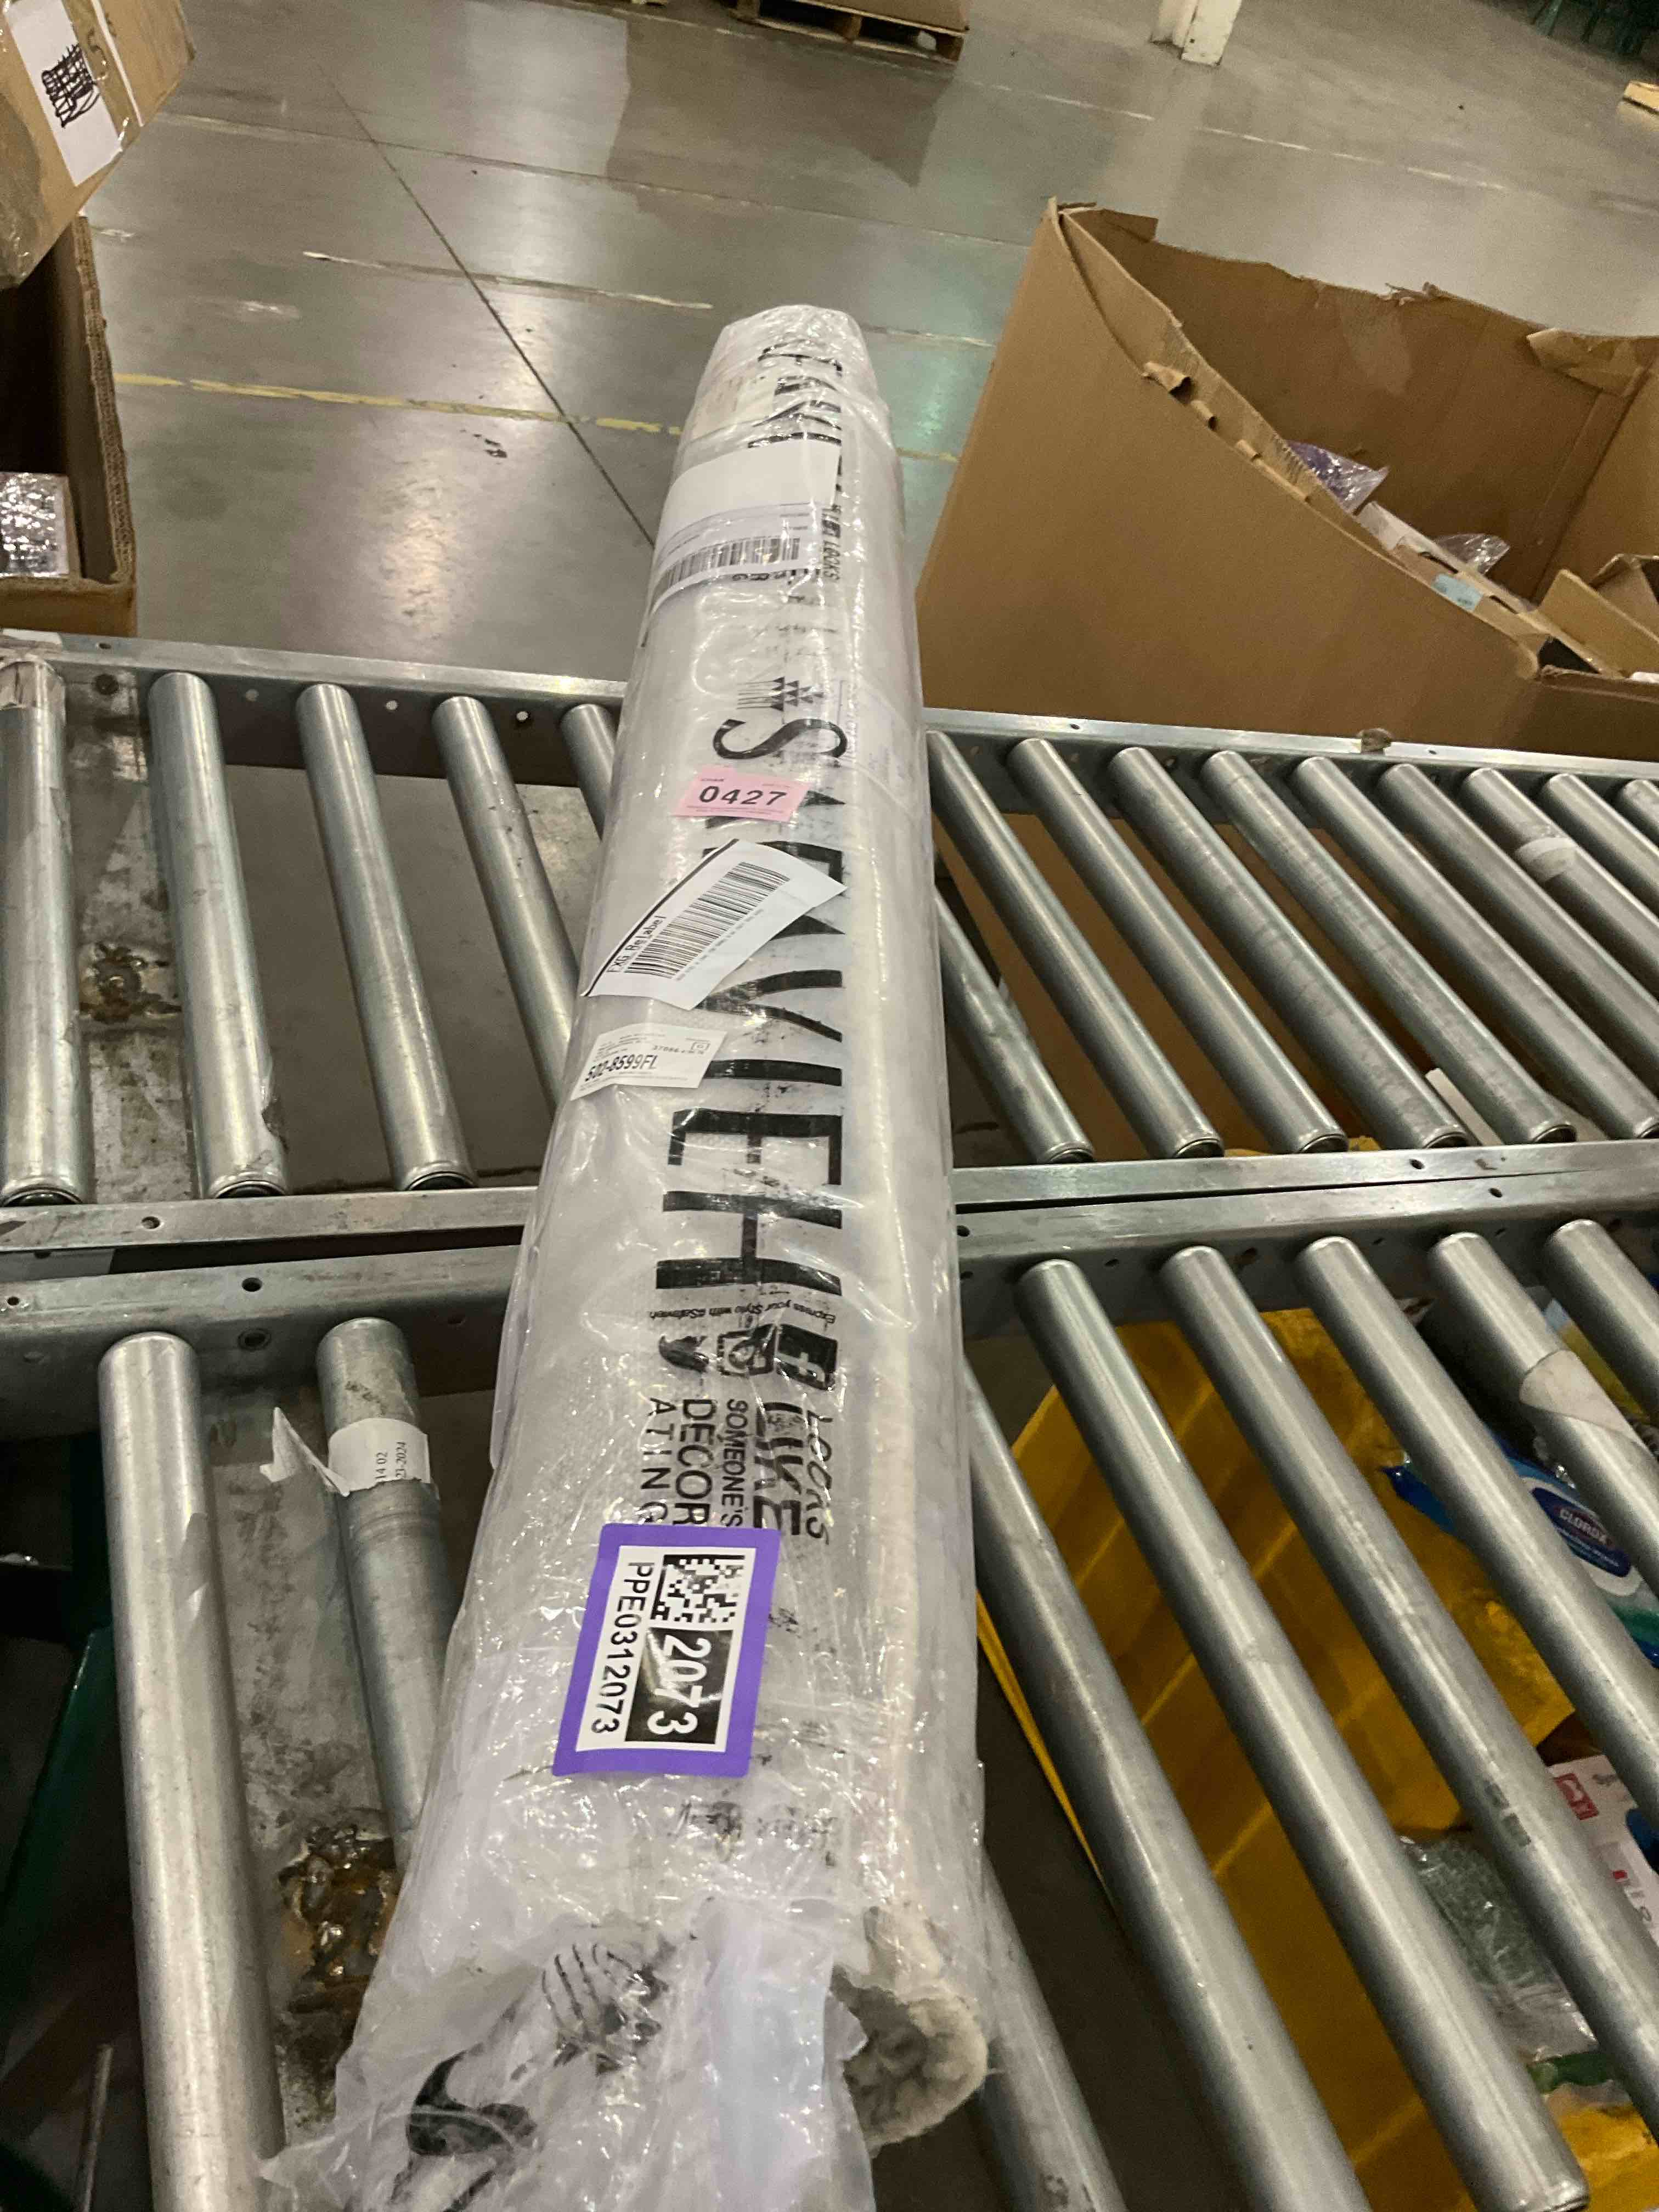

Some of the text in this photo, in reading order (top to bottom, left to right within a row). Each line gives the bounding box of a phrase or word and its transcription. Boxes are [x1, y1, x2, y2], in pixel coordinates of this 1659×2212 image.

[699, 786, 787, 805] 0427
[673, 1398, 717, 1526] DECOR
[721, 1398, 749, 1527] SOMEONE'S
[591, 1562, 655, 1733] PPE0312073
[647, 1634, 712, 1735] 2073
